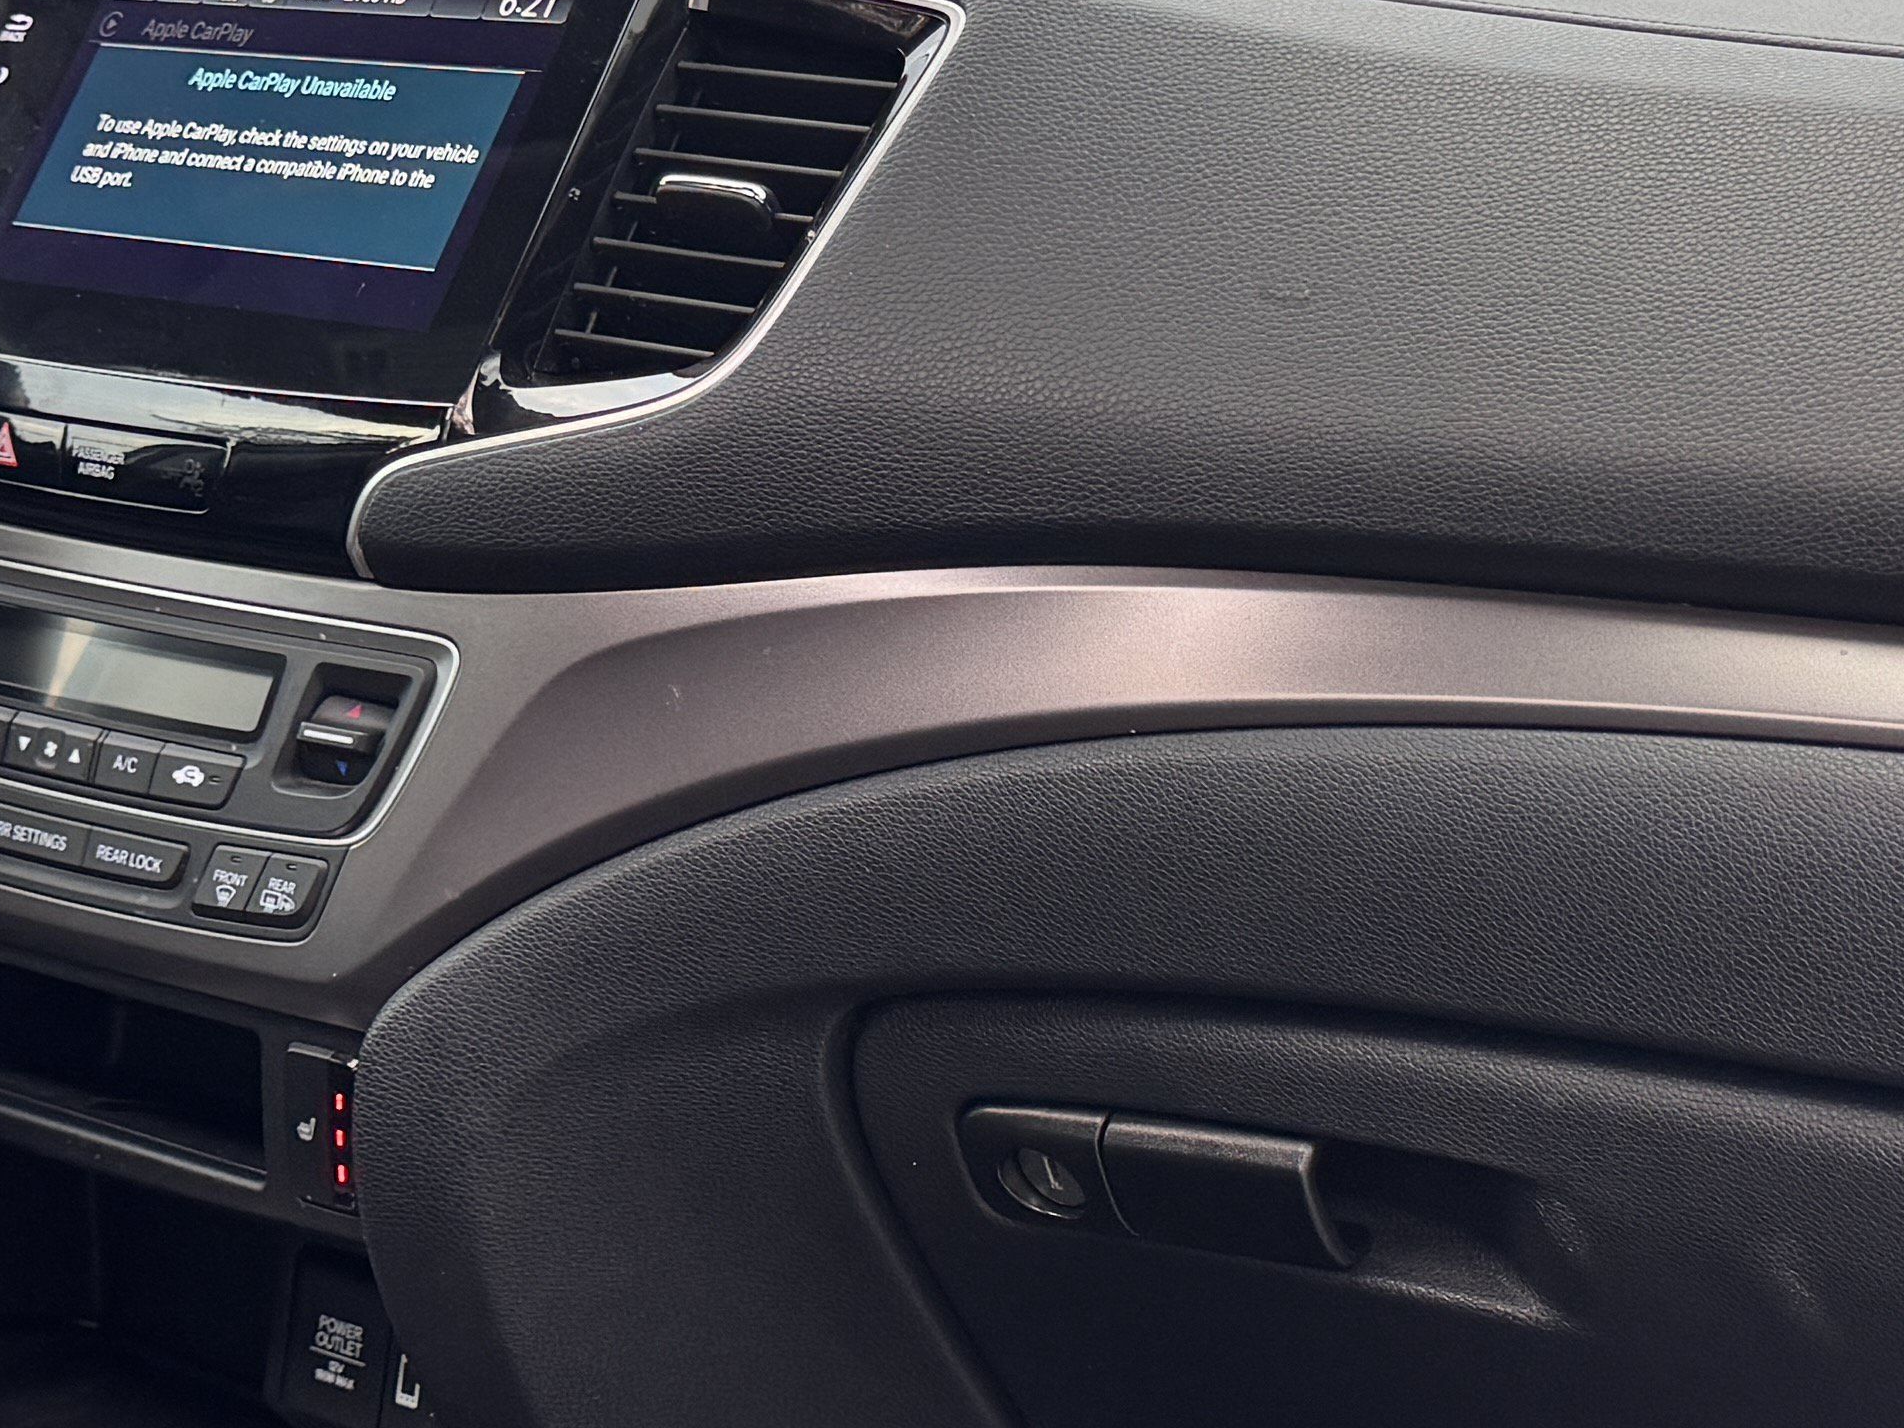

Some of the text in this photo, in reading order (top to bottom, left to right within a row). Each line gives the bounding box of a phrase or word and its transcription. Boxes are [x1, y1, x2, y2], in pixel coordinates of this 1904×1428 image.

[142, 17, 254, 48] Apple CarPlay
[188, 67, 396, 102] Apple CarPlay Unavailable
[97, 113, 480, 165] To use Apple CarPlay, check the settings on your vehicle
[70, 164, 133, 188] USB port.
[82, 141, 113, 159] and
[110, 142, 159, 163] iPhone
[158, 147, 190, 165] and
[187, 152, 245, 172] connect
[255, 158, 338, 180] compatible
[336, 162, 391, 185] iPhone
[390, 170, 408, 186] to
[407, 168, 436, 189] the
[72, 445, 126, 466] PASSENGER
[77, 461, 116, 481] AIRBAG
[113, 754, 139, 774] A/C
[12, 823, 68, 852] SETTINGS
[96, 844, 164, 874] REAR LOCK
[212, 869, 249, 888] FRONT
[267, 876, 297, 896] REAR
[318, 1314, 364, 1341] POWER
[315, 1330, 364, 1359] OUTLET
